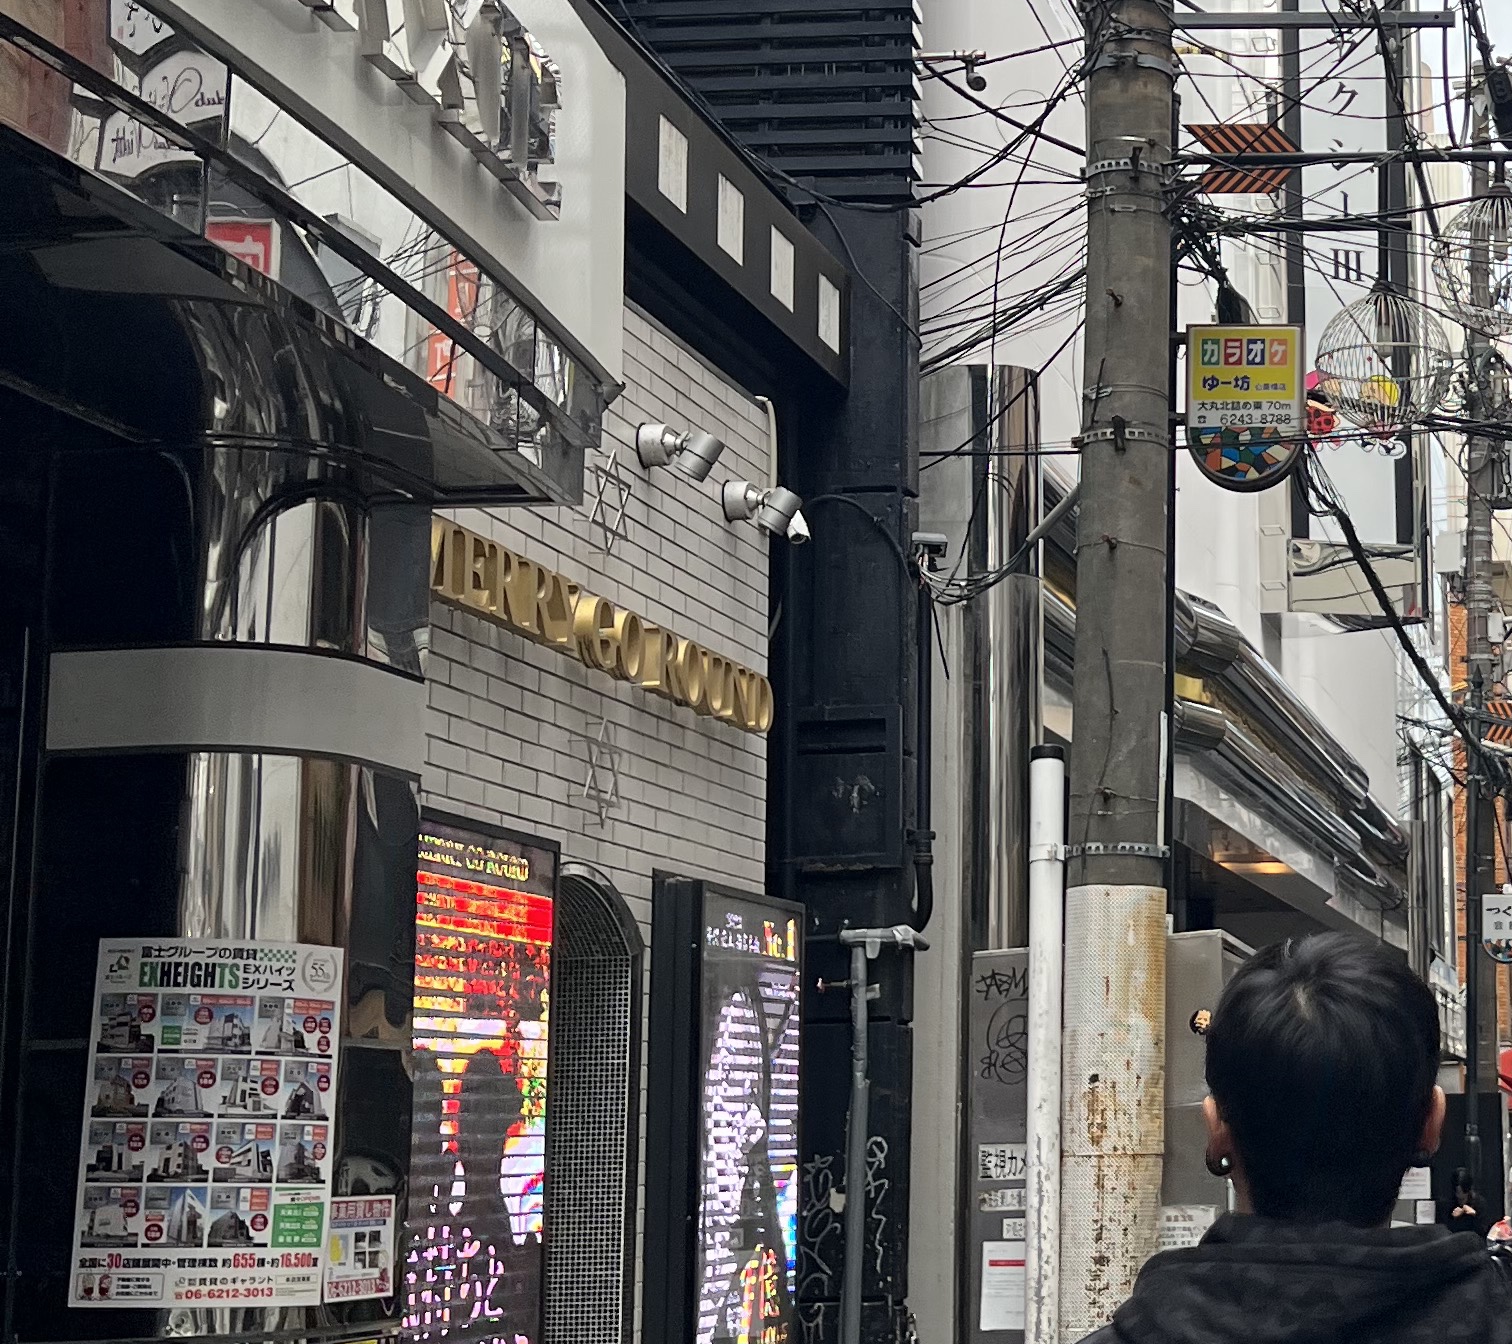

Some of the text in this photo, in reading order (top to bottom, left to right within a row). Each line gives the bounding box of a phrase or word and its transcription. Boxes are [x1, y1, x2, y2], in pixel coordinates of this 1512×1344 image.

[1201, 338, 1288, 366] カラオケ
[1201, 375, 1251, 392] ゆー坊
[1266, 401, 1292, 411] 70m
[1219, 413, 1292, 426] 6243-8788
[572, 593, 646, 684] GO
[640, 618, 775, 734] ROUND
[138, 961, 241, 989] EXHEIGHTS
[242, 977, 296, 993] シリーズ
[185, 1287, 274, 1299] 06-6212-3013
